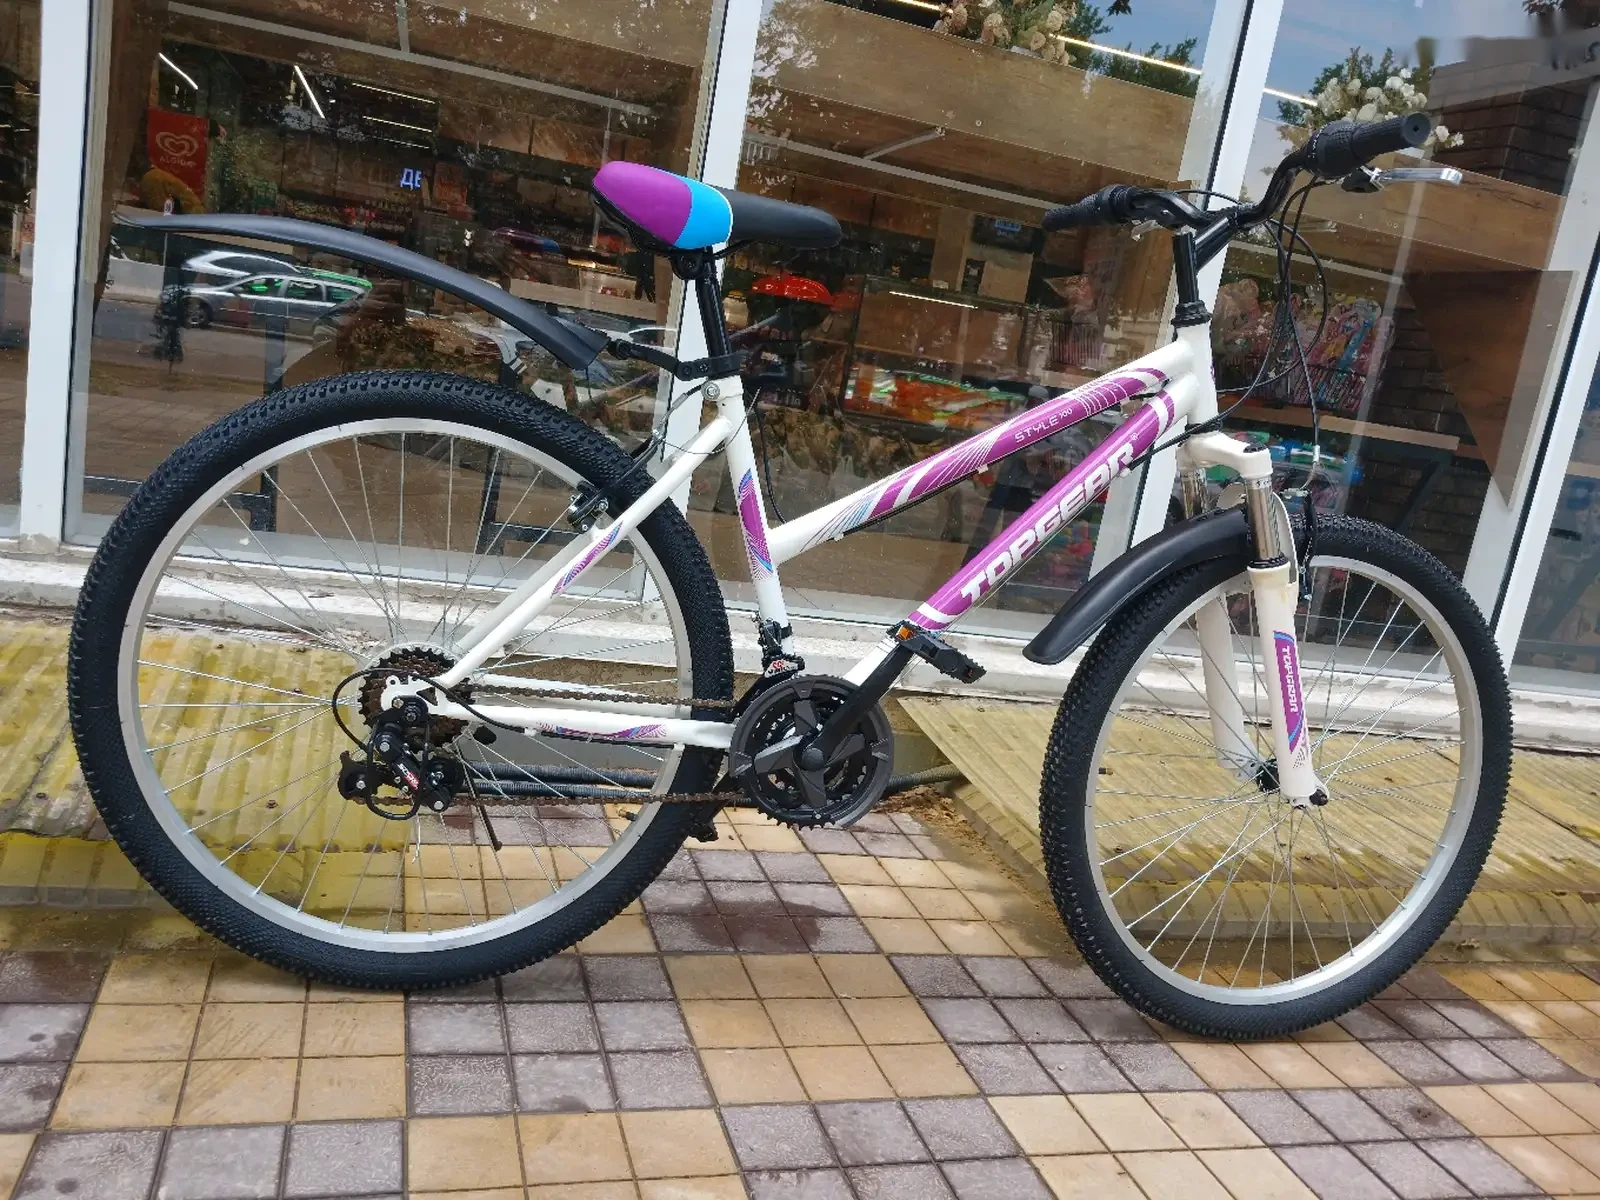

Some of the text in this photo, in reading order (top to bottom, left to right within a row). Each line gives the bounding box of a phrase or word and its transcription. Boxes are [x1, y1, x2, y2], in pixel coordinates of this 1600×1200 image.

[1014, 414, 1060, 443] STYLE
[960, 442, 1134, 602] TOPGEAR
[1282, 645, 1299, 713] TOPGEAR
